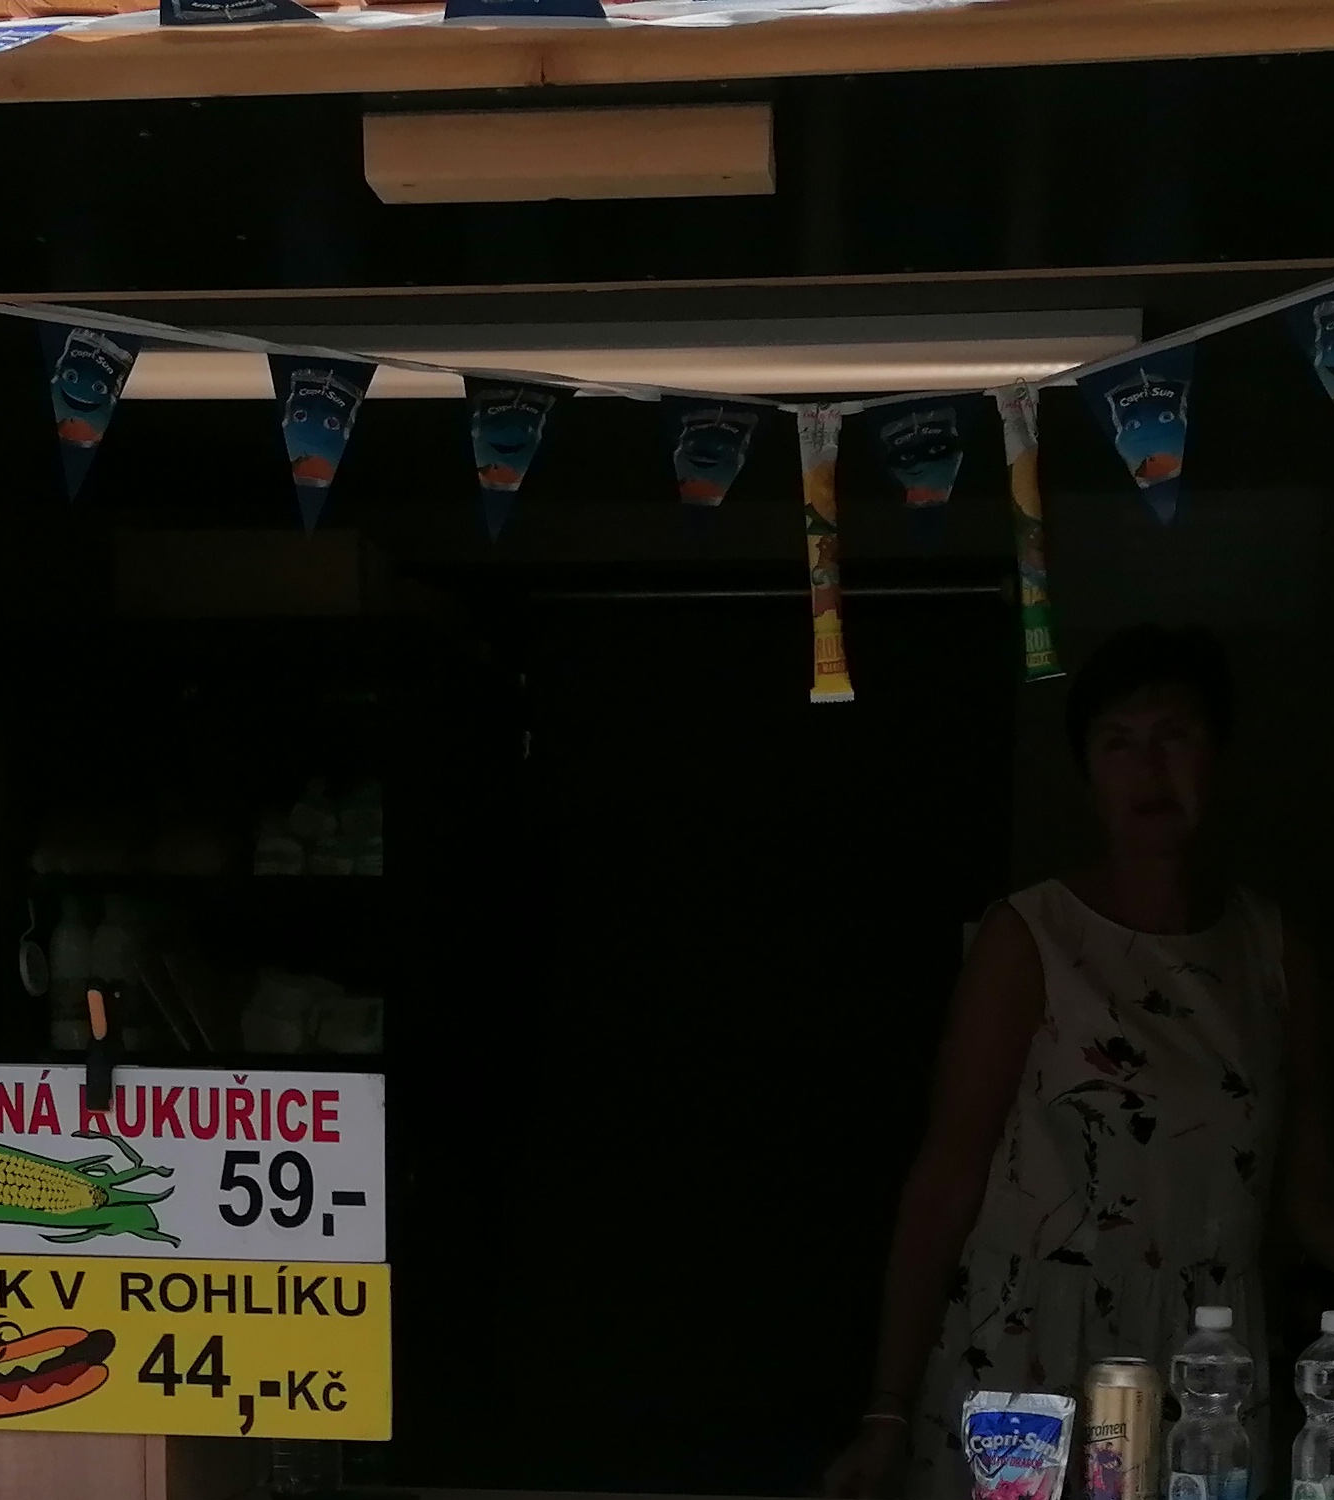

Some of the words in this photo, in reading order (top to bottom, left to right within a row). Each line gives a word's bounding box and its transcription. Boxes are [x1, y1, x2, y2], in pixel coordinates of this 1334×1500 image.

[218, 1149, 367, 1237] 59,-
[49, 1269, 86, 1310] V
[119, 1265, 367, 1317] ROHLÍKU
